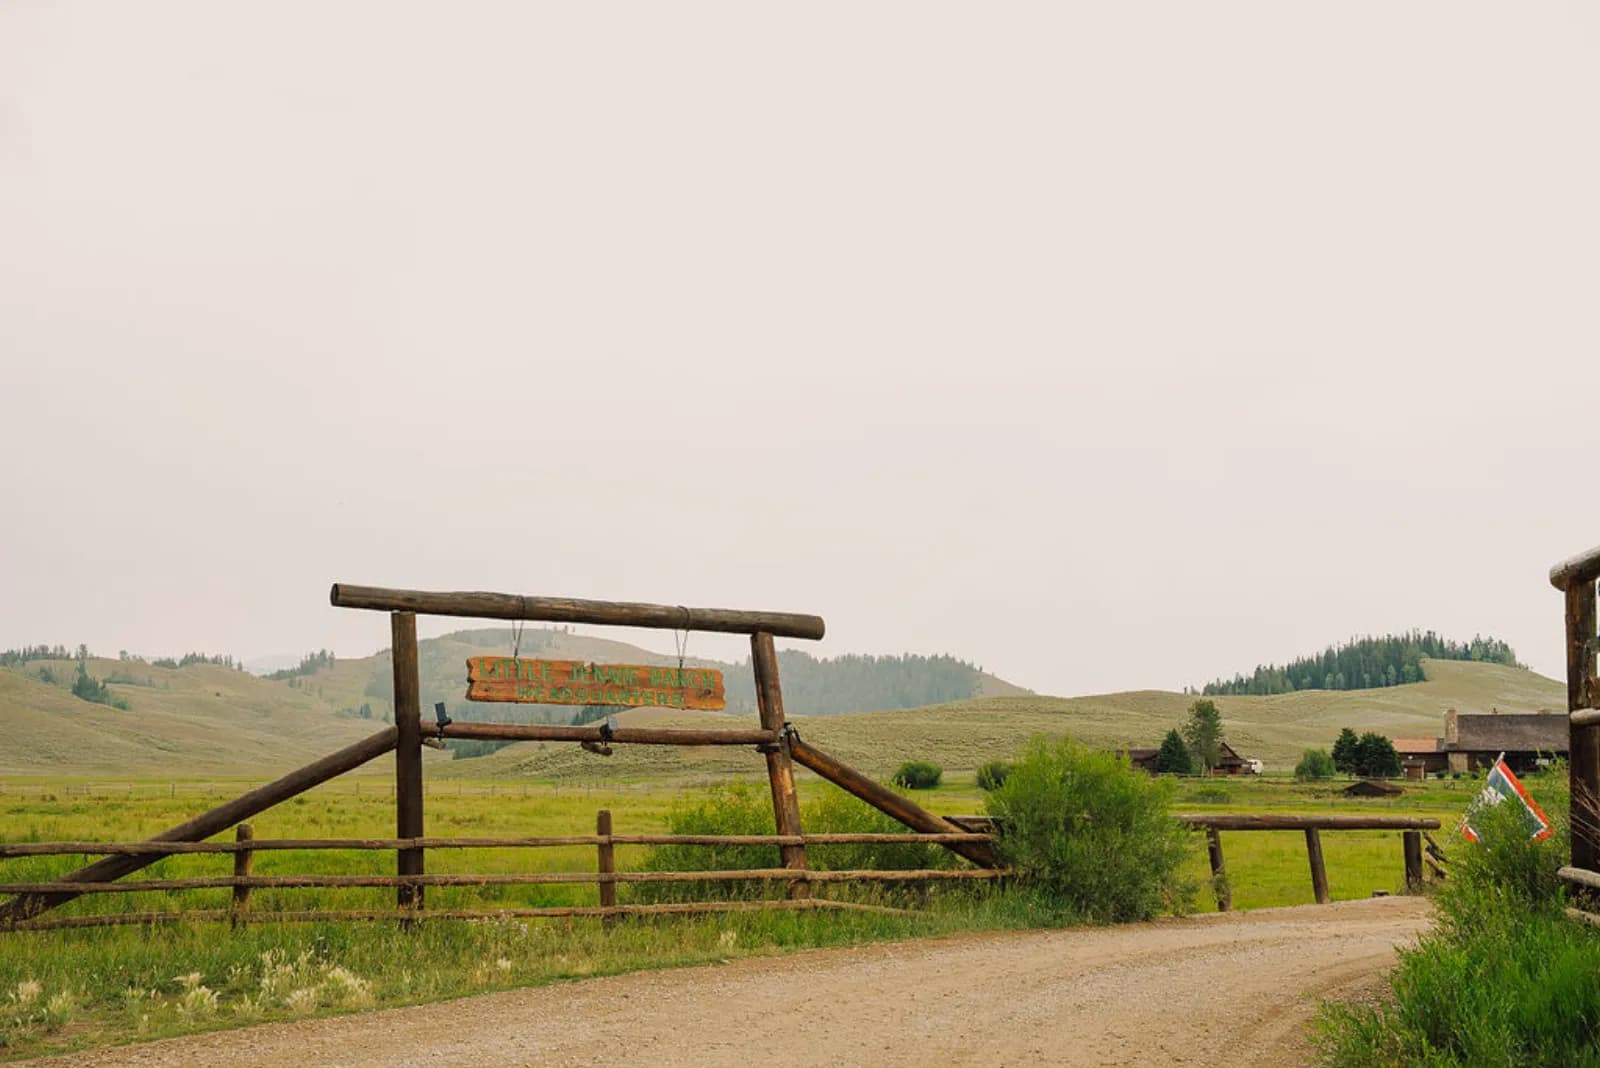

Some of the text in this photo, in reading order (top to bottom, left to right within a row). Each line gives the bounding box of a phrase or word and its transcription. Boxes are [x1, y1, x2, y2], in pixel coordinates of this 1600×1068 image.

[480, 660, 715, 689] LITTLE JENNIE RANCH
[518, 686, 682, 705] HEADQUARTERS
